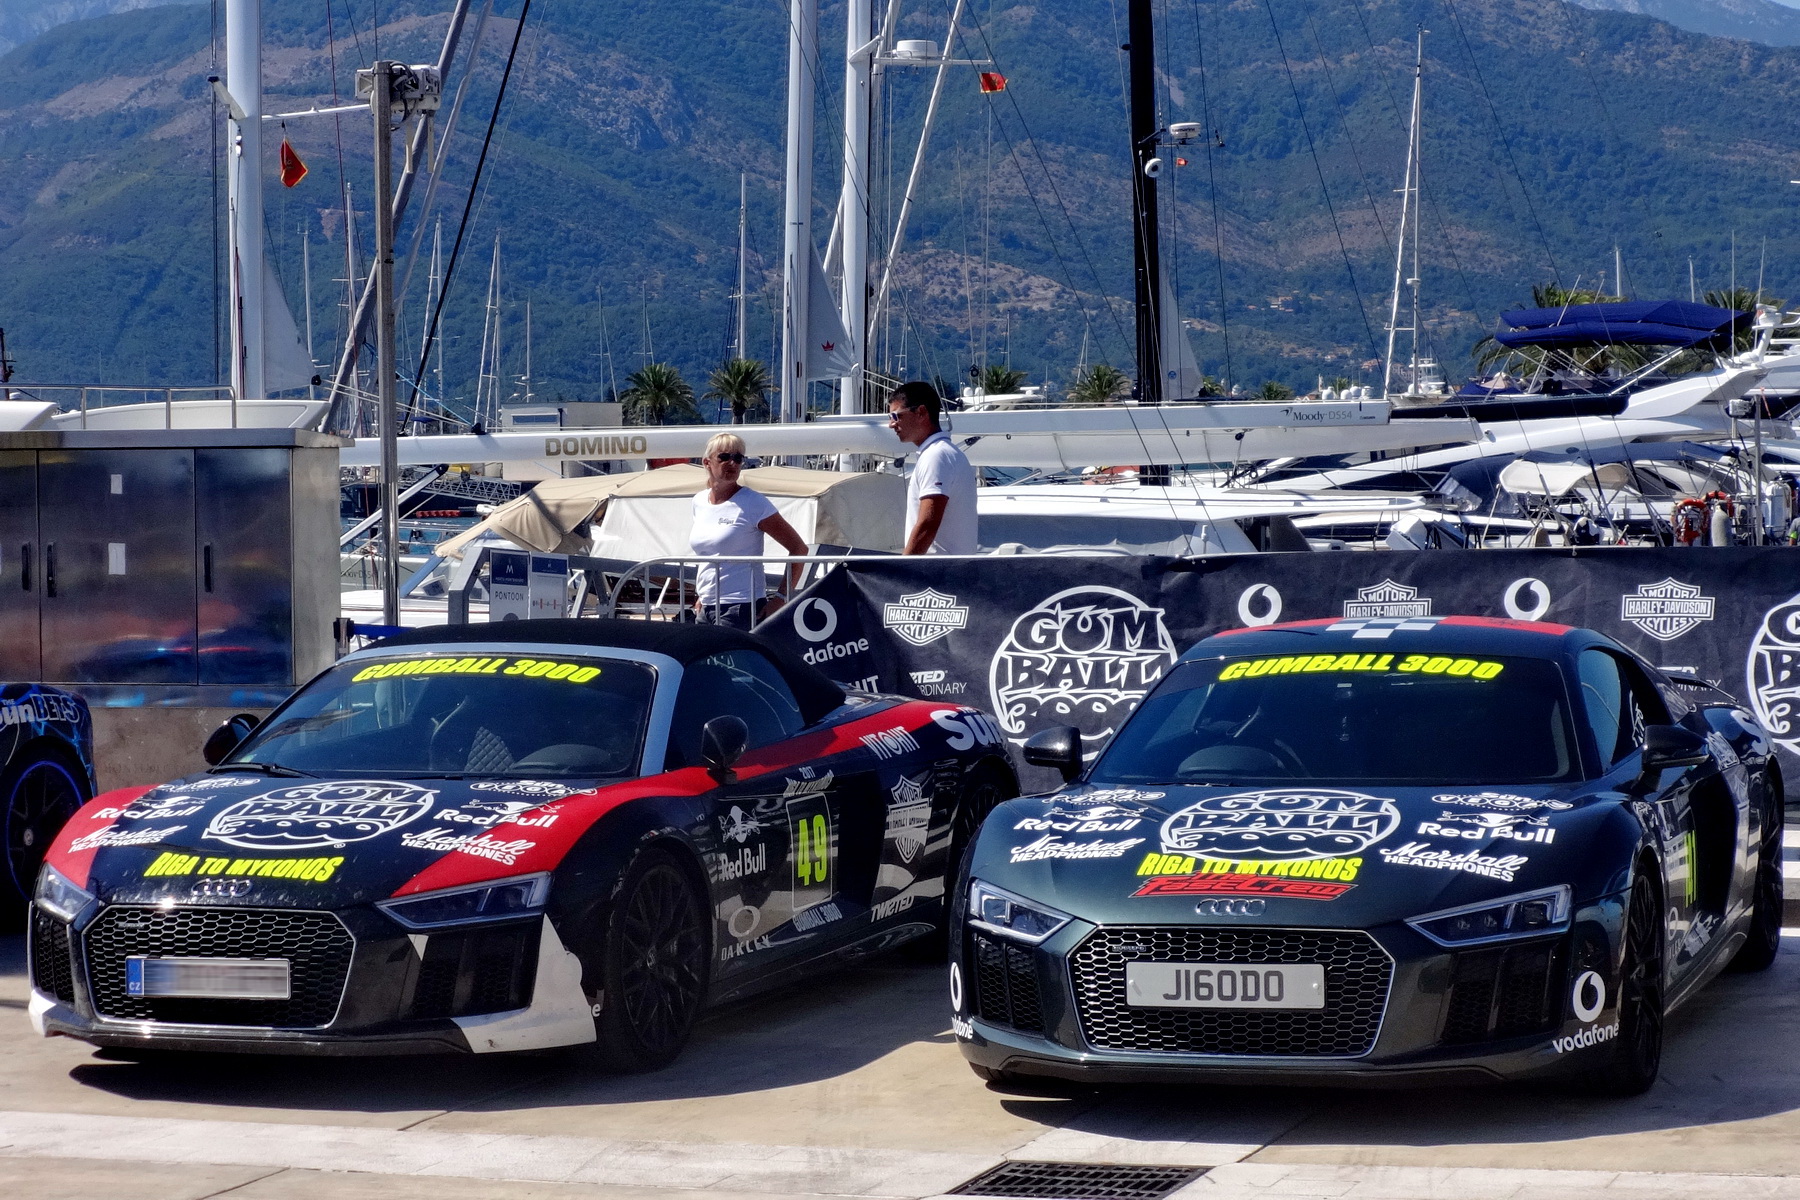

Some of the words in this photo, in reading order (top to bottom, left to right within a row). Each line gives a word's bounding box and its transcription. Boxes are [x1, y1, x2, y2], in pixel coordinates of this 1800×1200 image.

[1293, 411, 1325, 423] Moody
[545, 436, 647, 456] DOMINO
[494, 591, 524, 601] PONTOON
[909, 594, 948, 608] MOTOR
[1368, 587, 1407, 602] MOTOR
[1649, 586, 1692, 598] MOTOR
[889, 608, 962, 623] HARLEY-DAVIDSON
[1349, 604, 1424, 617] HARLEY-DAVIDSON
[1629, 601, 1707, 614] HARLEY-DAVIDSON
[903, 624, 943, 640] CYCLES
[1646, 617, 1688, 634] CYCLES
[351, 658, 507, 682] GUMBALL
[504, 659, 601, 683] 3000
[1219, 654, 1395, 681] GUMBALL
[1397, 655, 1504, 679] 3000
[91, 807, 151, 819] Red
[145, 805, 204, 819] Bull
[433, 809, 499, 825] Red
[496, 813, 559, 828] Bull
[1013, 818, 1081, 832] Red
[1076, 819, 1141, 832] Bull
[1417, 822, 1486, 839] Red
[1490, 826, 1556, 844] Bull
[68, 837, 164, 853] HEADPHONES
[402, 827, 537, 855] Marshall
[798, 814, 828, 886] 49
[401, 839, 517, 866] HEADPHONES
[721, 848, 743, 881] Red
[744, 842, 767, 876] Bull
[1010, 848, 1125, 863] HEADPHONES
[1379, 841, 1529, 871] Marshall
[144, 852, 200, 877] RIGA
[197, 857, 230, 875] TO
[225, 856, 344, 882] MYKONOS
[1137, 853, 1196, 876] RIGA
[1201, 858, 1233, 874] TO
[1234, 858, 1363, 881] MYKONOS
[1384, 855, 1515, 882] HEADPHONES
[721, 934, 772, 961] OAKLEY
[129, 982, 141, 991] CZ
[1552, 1022, 1619, 1054] vodafone
